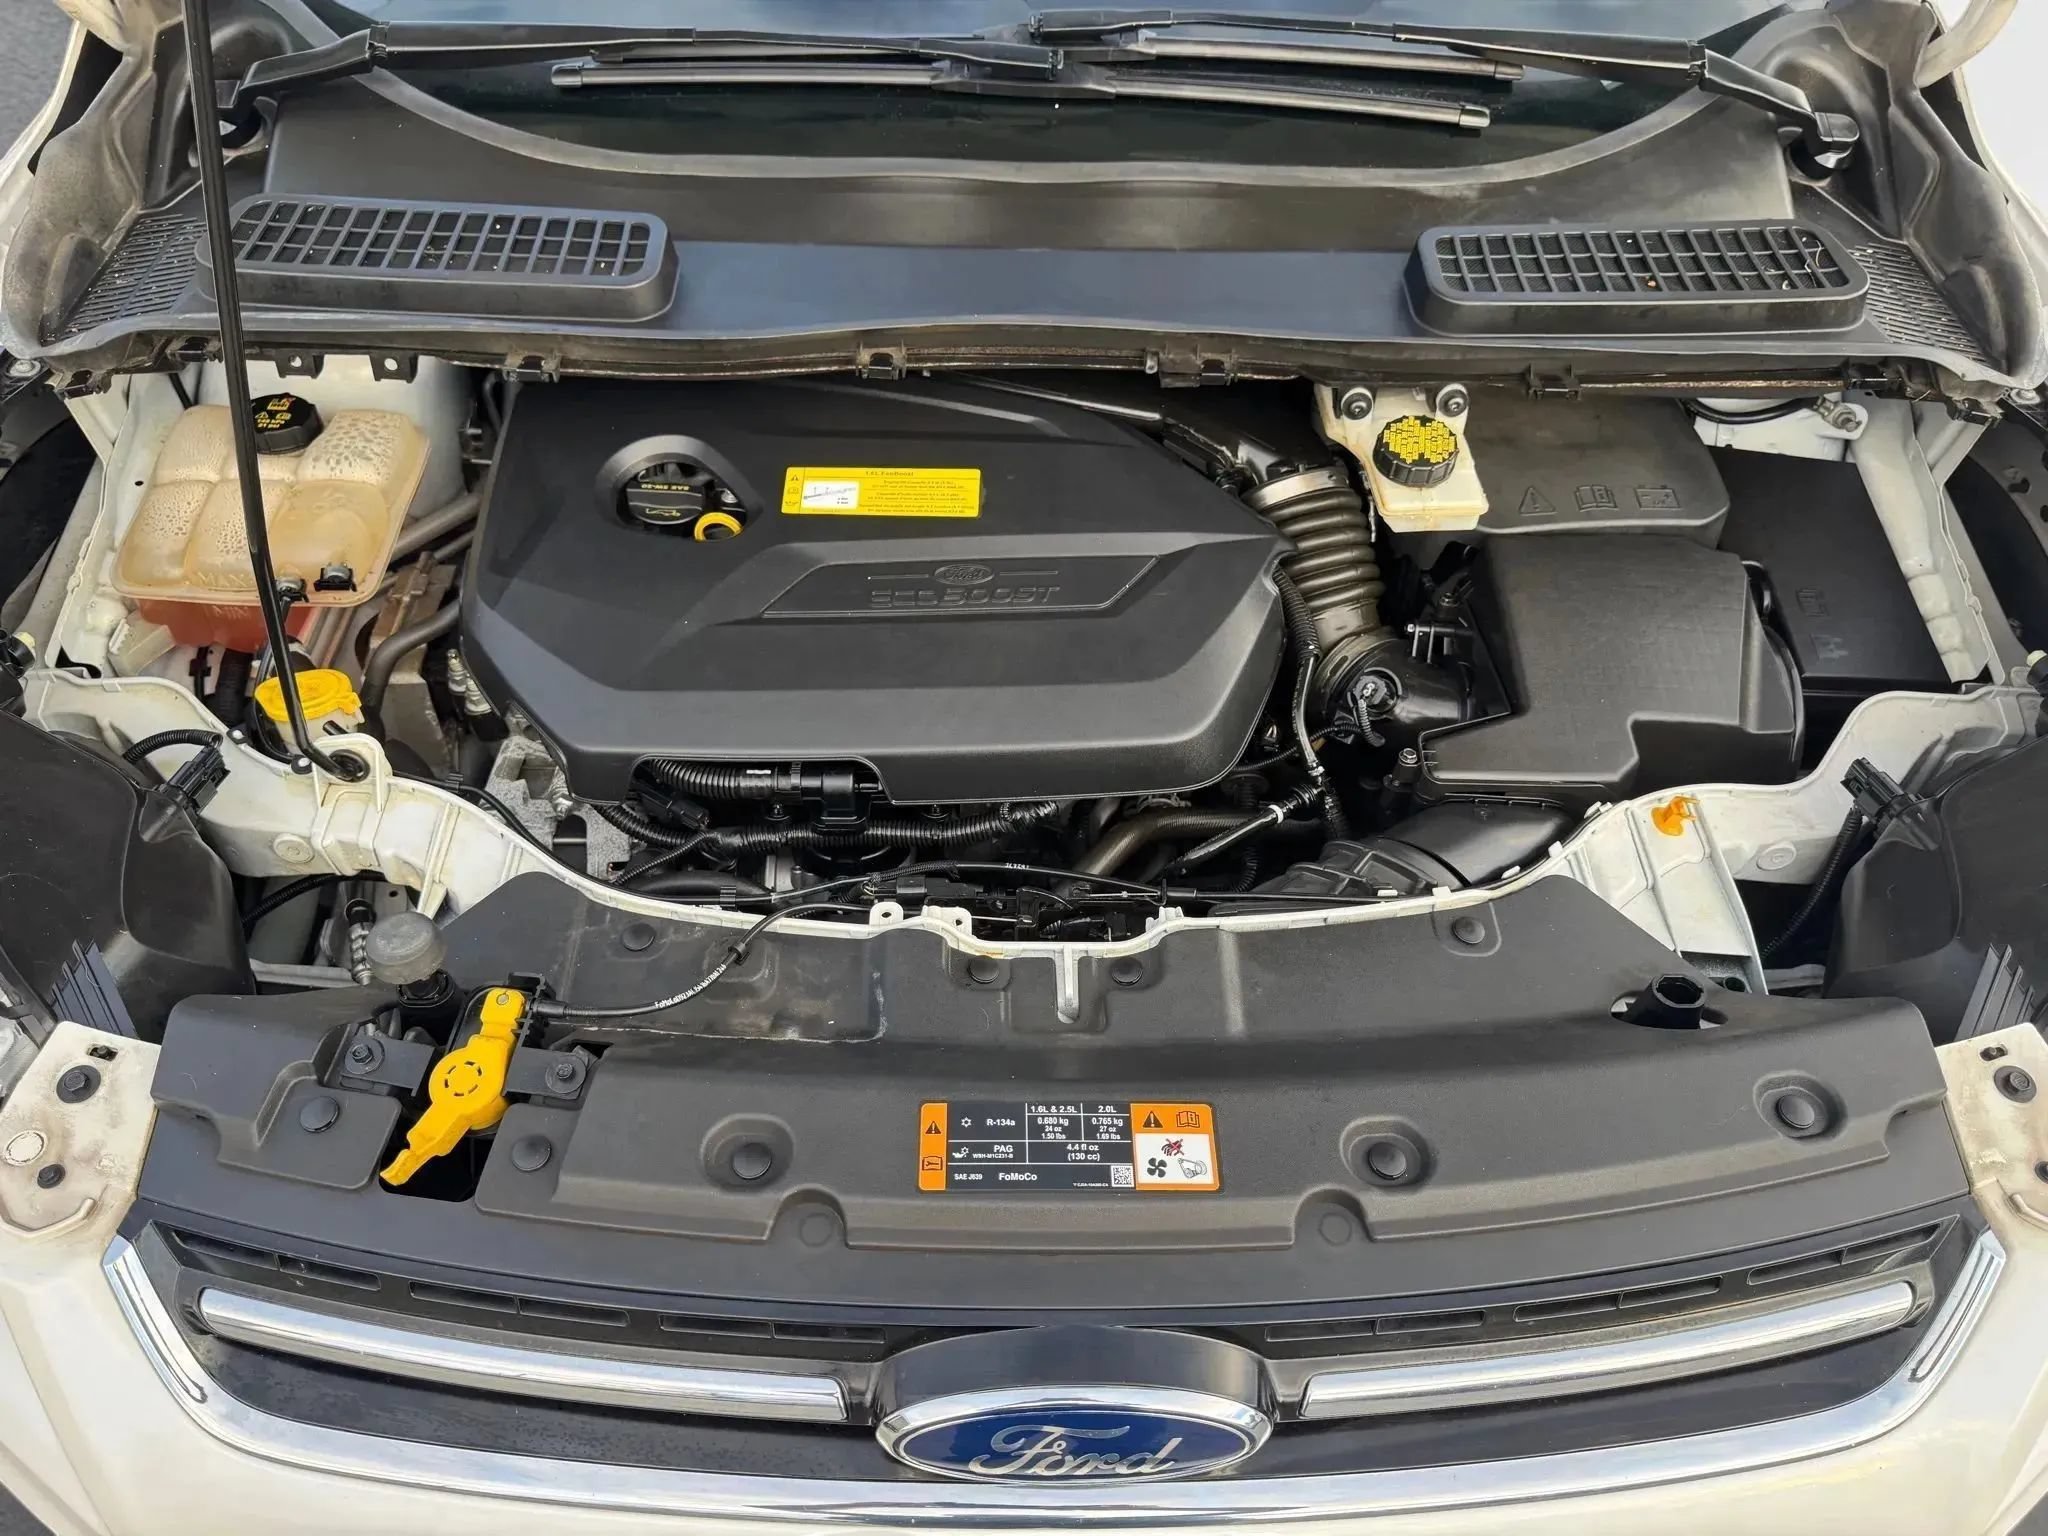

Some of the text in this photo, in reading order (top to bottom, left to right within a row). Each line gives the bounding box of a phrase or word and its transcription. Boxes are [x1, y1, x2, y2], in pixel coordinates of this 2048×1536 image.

[1059, 1117, 1069, 1126] kg
[1113, 1117, 1123, 1126] kg
[994, 1144, 1013, 1153] PAG
[1067, 1153, 1100, 1161] (130 cc)
[999, 1172, 1037, 1181] FoMoCo
[967, 1423, 1183, 1476] Ford
